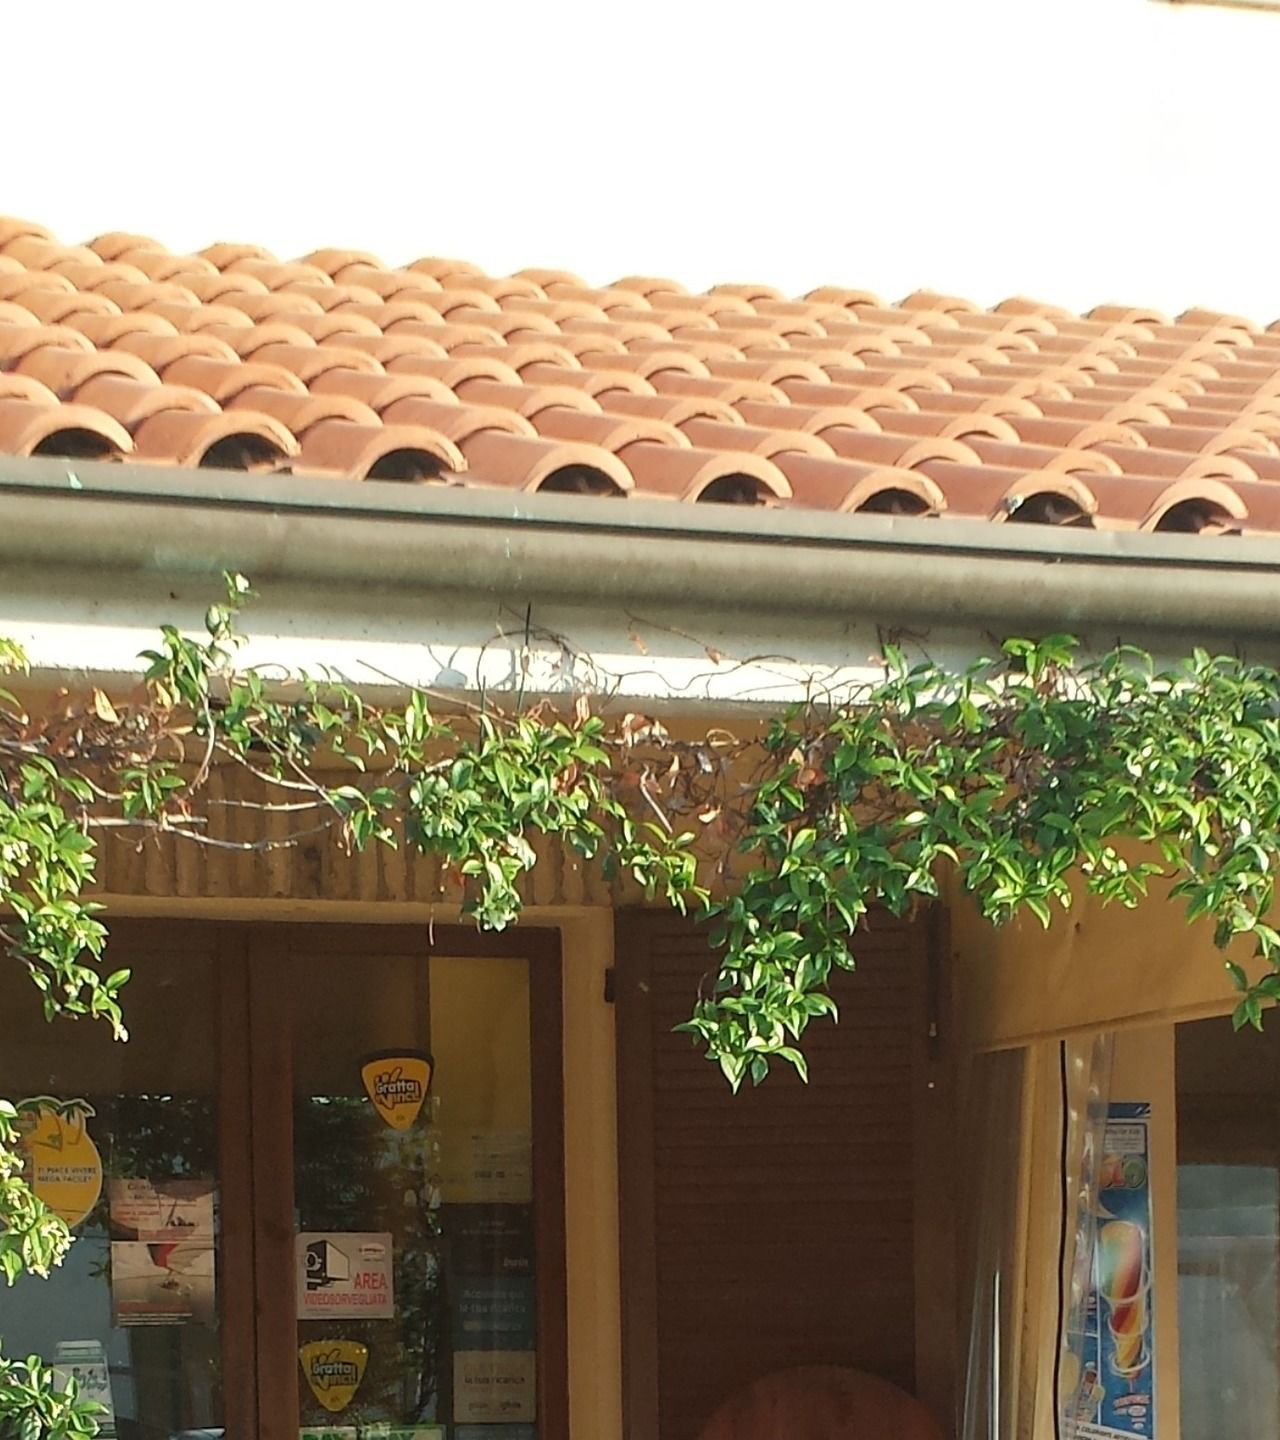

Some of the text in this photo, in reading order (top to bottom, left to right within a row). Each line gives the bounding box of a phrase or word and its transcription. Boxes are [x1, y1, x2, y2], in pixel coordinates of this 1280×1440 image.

[376, 1080, 414, 1094] Gratta
[353, 1272, 388, 1290] AREA
[303, 1293, 387, 1305] VIDEOSORVEGLIATA
[312, 1362, 351, 1375] Gratta
